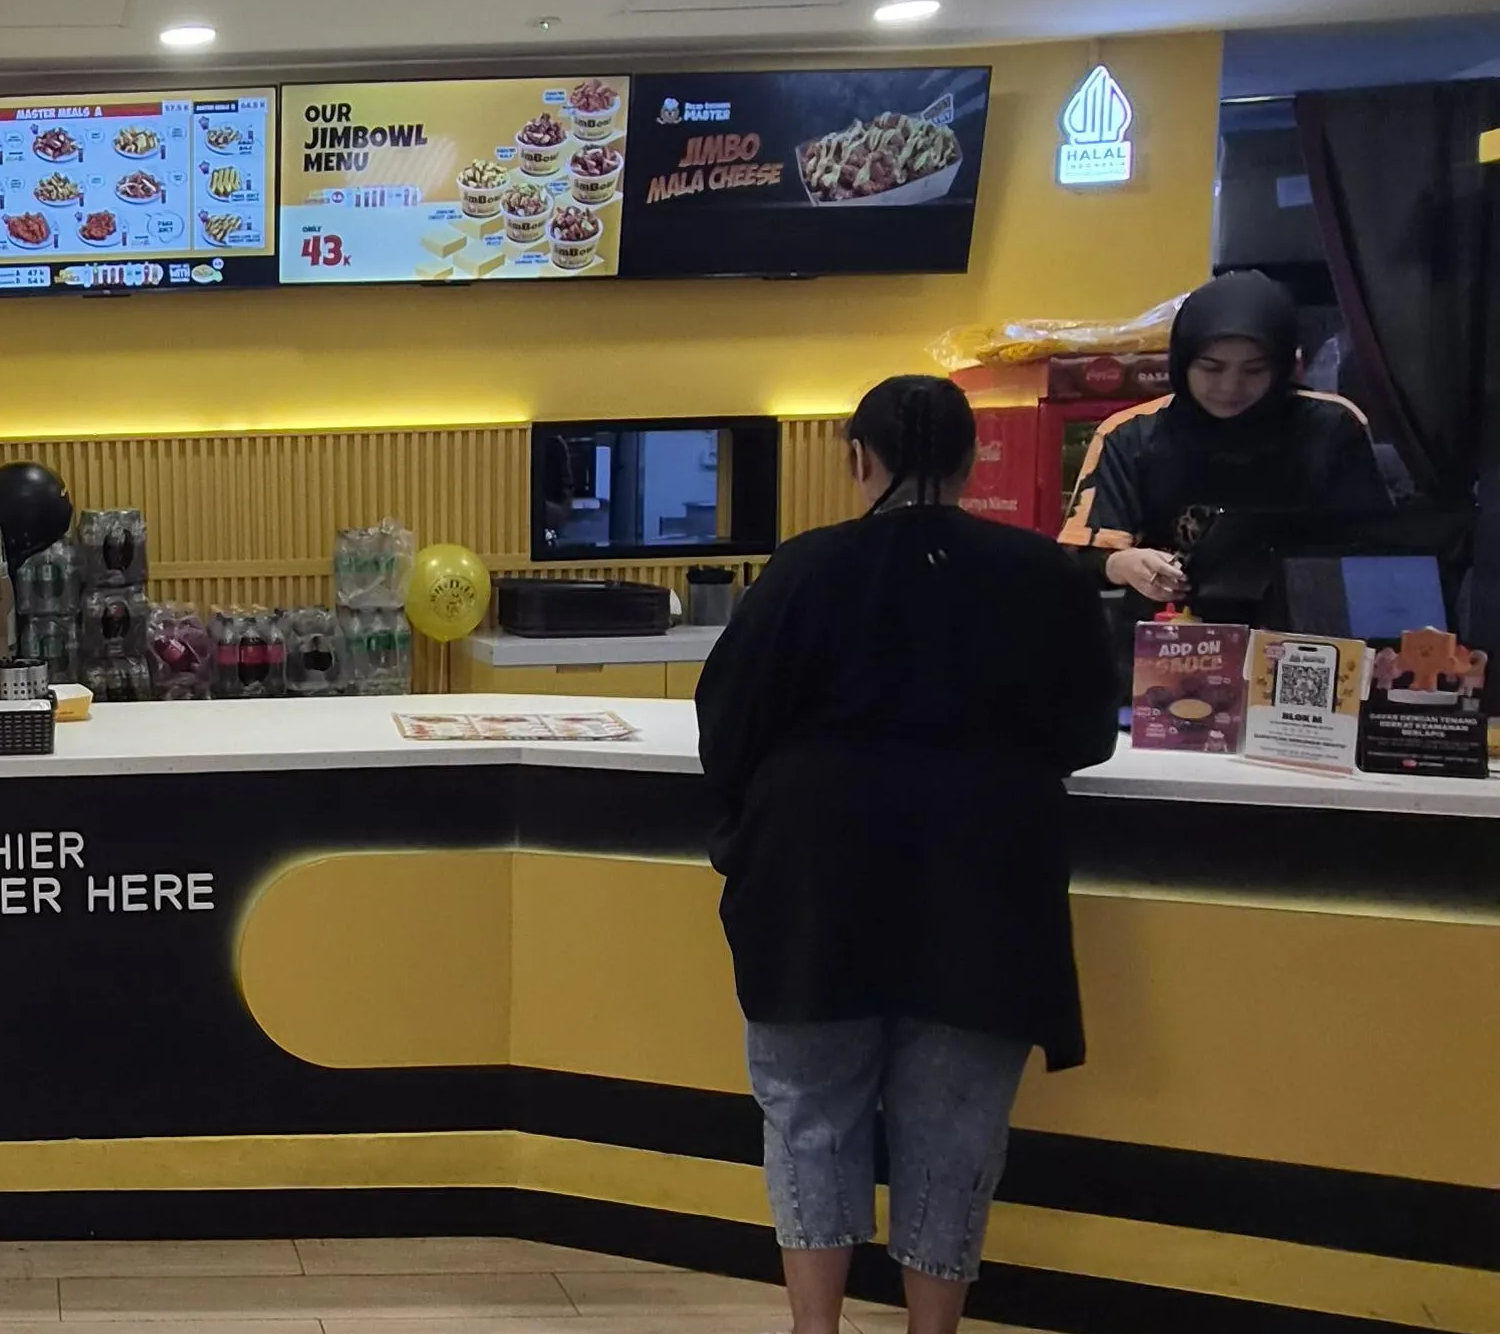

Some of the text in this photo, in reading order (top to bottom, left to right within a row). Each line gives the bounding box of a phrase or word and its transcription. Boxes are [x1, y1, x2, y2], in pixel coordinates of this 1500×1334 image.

[16, 108, 55, 120] MASTER
[304, 103, 352, 123] OUR
[304, 124, 428, 150] JIMBOWL
[678, 133, 760, 167] JIMBO
[1066, 145, 1127, 162] HALAL
[303, 151, 369, 173] MENU
[646, 162, 784, 204] MALA CHEESE
[1158, 640, 1221, 658] ADD ON
[88, 873, 215, 913] HERE
